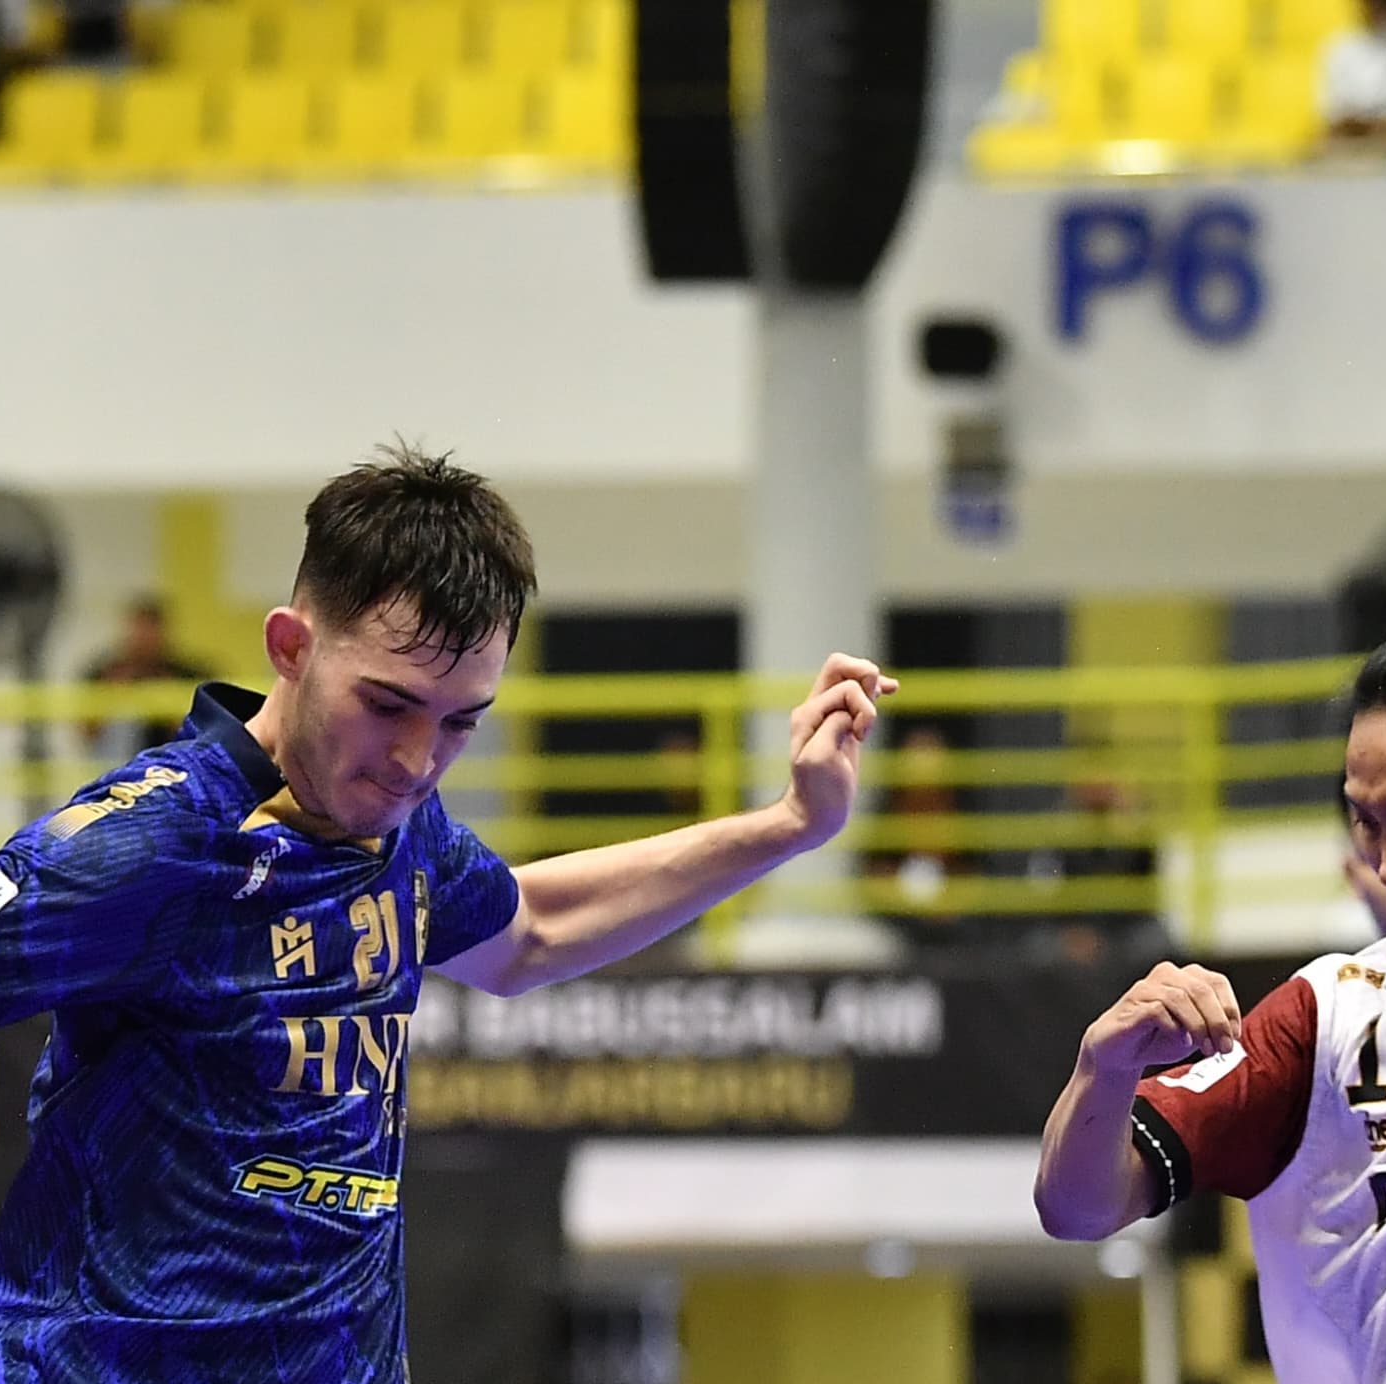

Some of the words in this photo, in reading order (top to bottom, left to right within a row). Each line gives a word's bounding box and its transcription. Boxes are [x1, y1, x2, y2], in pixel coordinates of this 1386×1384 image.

[1049, 194, 1267, 346] P6
[349, 890, 400, 992] 21
[269, 1013, 412, 1096] HN
